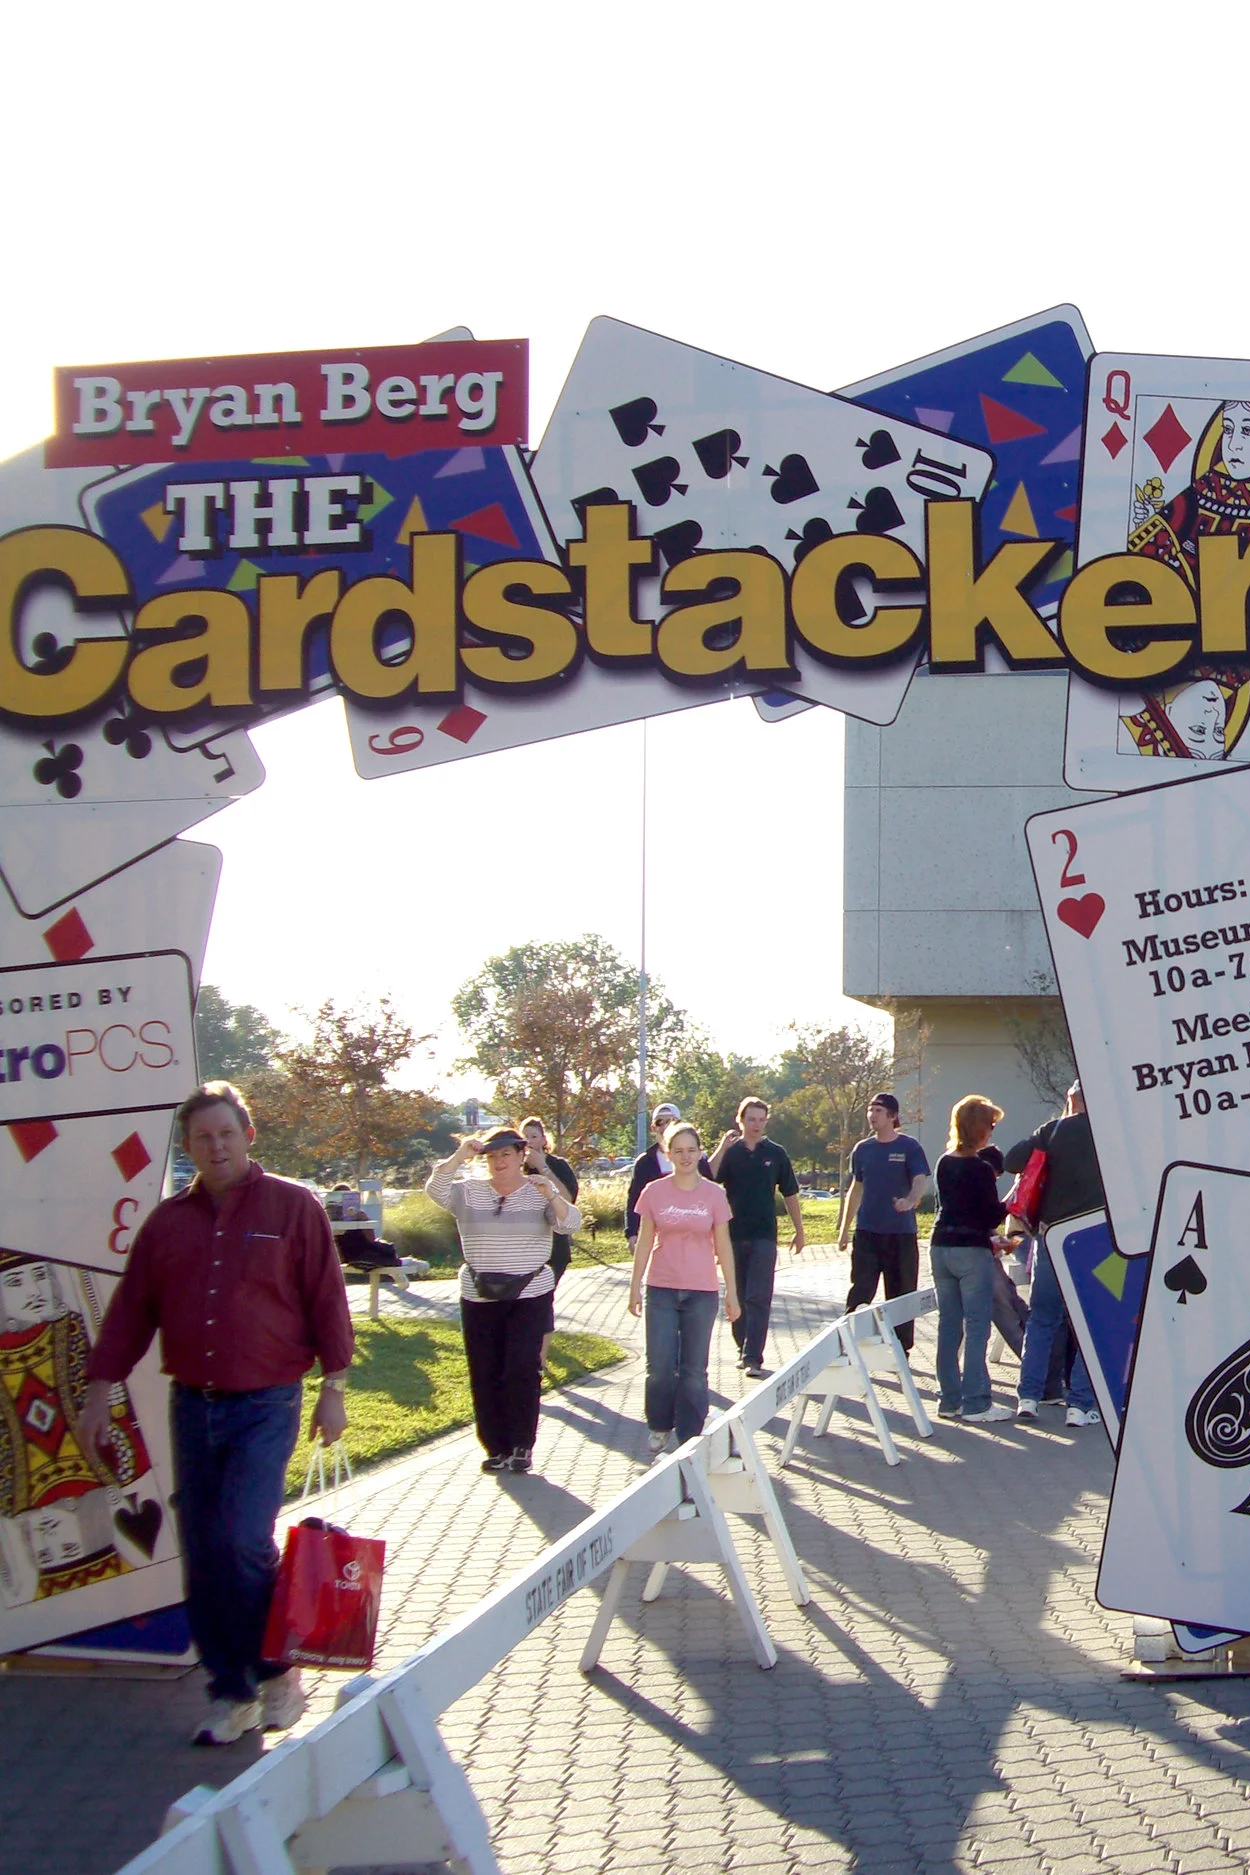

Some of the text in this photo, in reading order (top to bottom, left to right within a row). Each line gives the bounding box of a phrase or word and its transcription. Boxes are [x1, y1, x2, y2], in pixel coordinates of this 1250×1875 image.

[73, 361, 504, 447] Bryan Berg
[1102, 369, 1131, 421] Q
[906, 447, 967, 500] 10
[163, 473, 365, 552] THE
[1050, 829, 1087, 889] 2
[1134, 879, 1248, 919] Hours:
[98, 986, 132, 1006] BY
[1132, 1052, 1239, 1092] Bryan
[107, 1197, 139, 1255] 3
[1177, 1189, 1209, 1250] A
[525, 1575, 553, 1625] STATE
[556, 1558, 575, 1601] FAIR
[576, 1547, 587, 1581] OF
